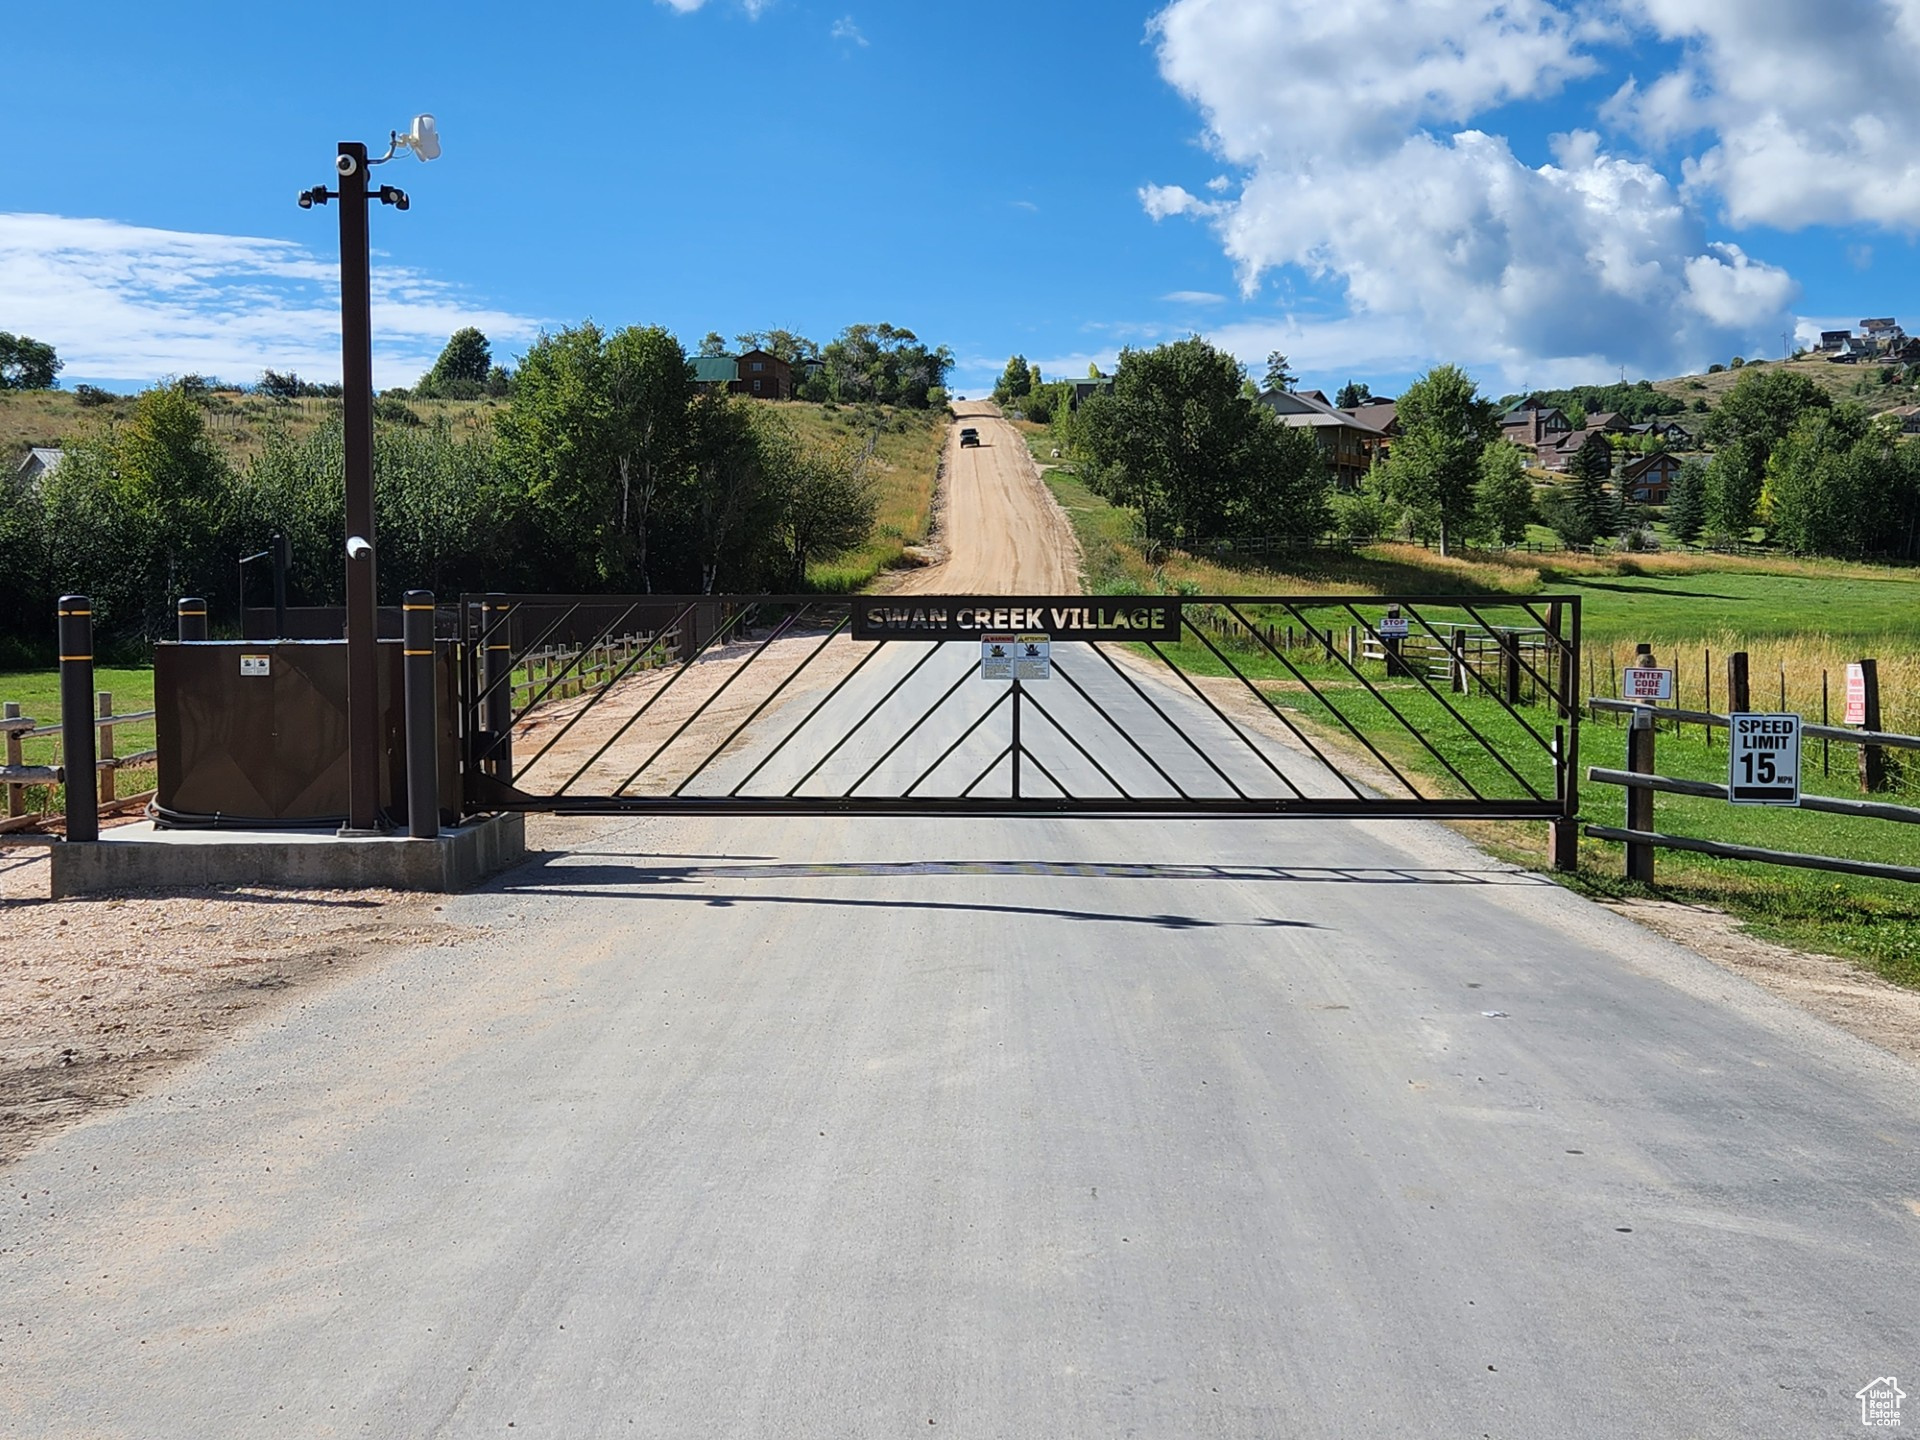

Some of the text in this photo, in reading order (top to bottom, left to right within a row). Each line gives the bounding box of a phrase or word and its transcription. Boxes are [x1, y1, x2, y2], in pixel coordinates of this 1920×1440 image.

[866, 608, 1165, 629] SWAN CREEK VILLAGE
[1633, 671, 1663, 680] ENTER
[1634, 680, 1661, 688] CODE
[1634, 687, 1661, 696] HERE
[1738, 719, 1794, 735] SPEED
[1742, 735, 1790, 750] LIMIT
[1739, 752, 1793, 784] 15 MPH
